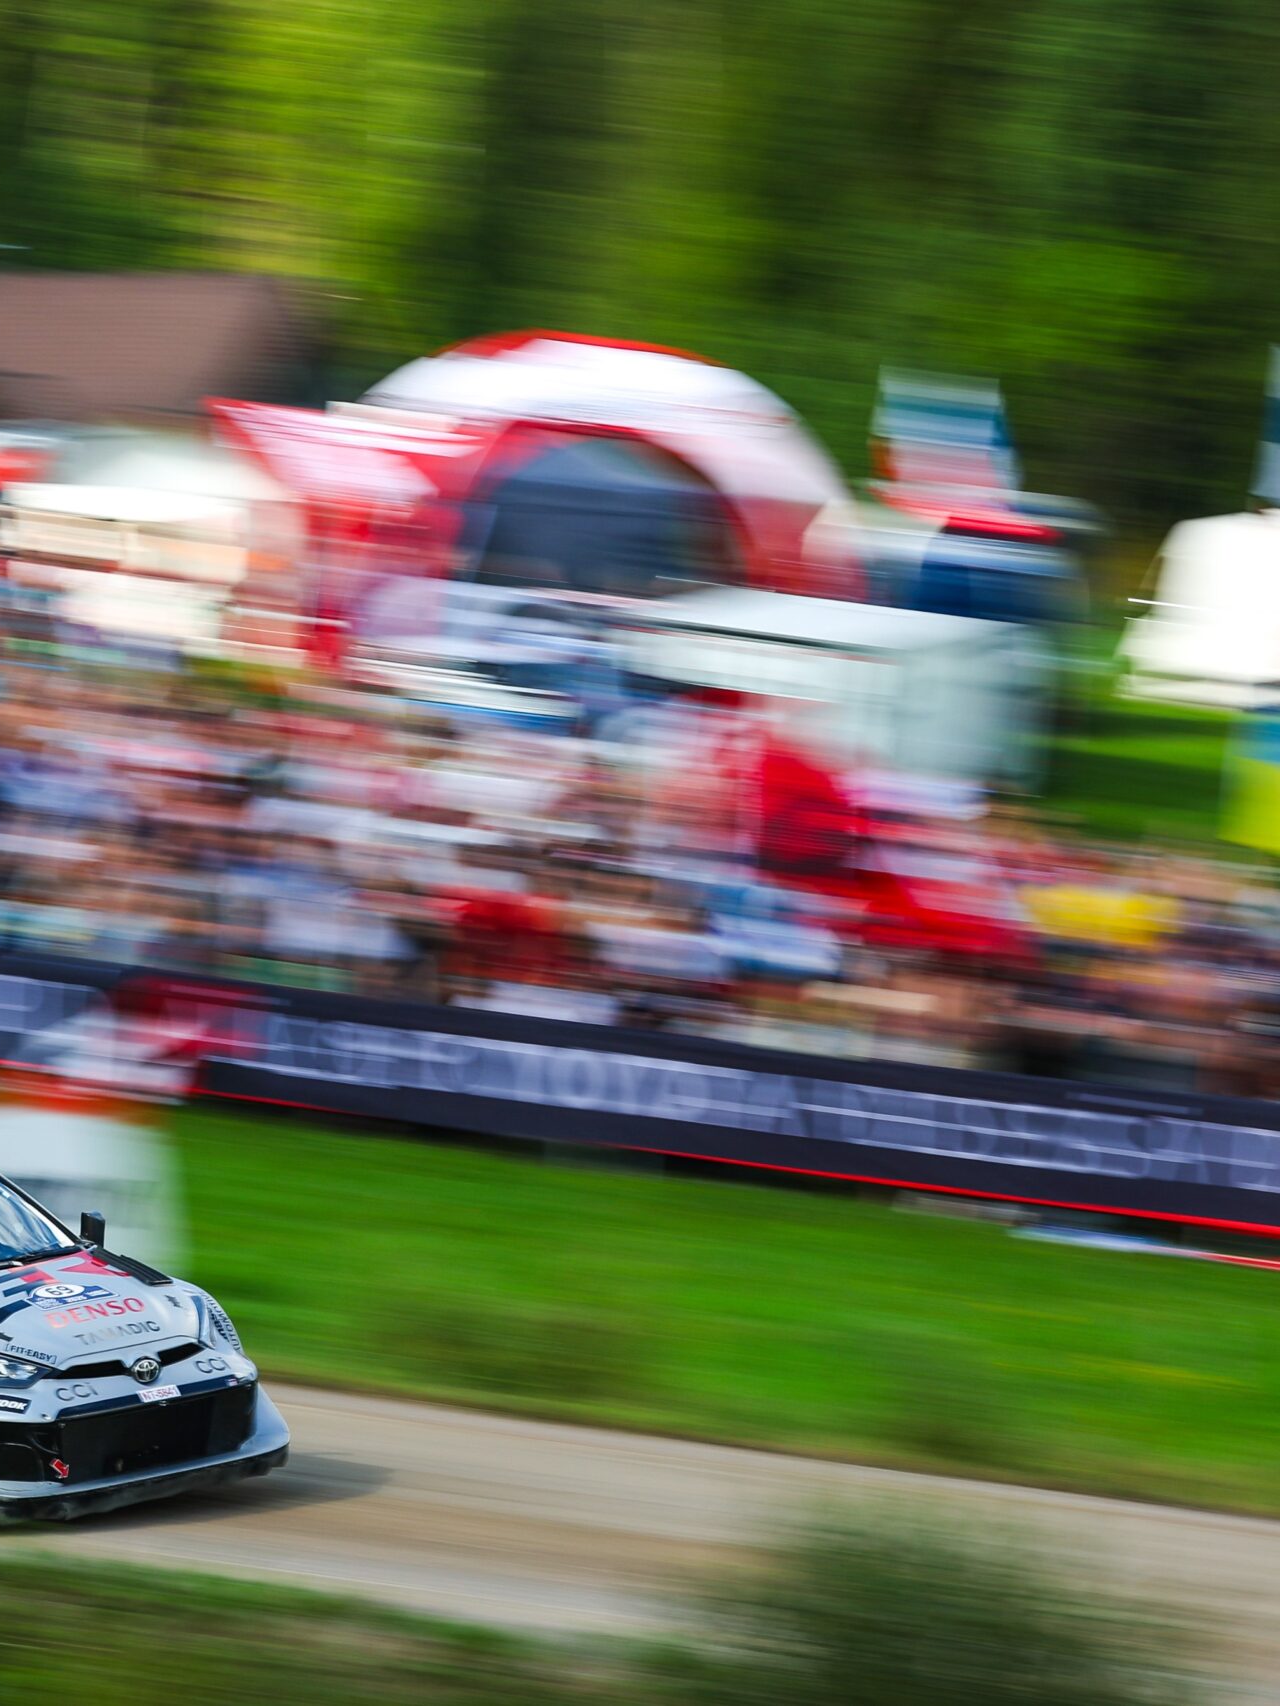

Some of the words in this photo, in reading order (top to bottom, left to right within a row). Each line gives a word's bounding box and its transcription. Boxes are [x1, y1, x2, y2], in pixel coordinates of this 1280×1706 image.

[45, 1286, 73, 1296] 69
[46, 1298, 144, 1329] DENSO
[74, 1321, 160, 1345] TAMADIC
[195, 1356, 231, 1373] CCi
[56, 1384, 98, 1401] CCi
